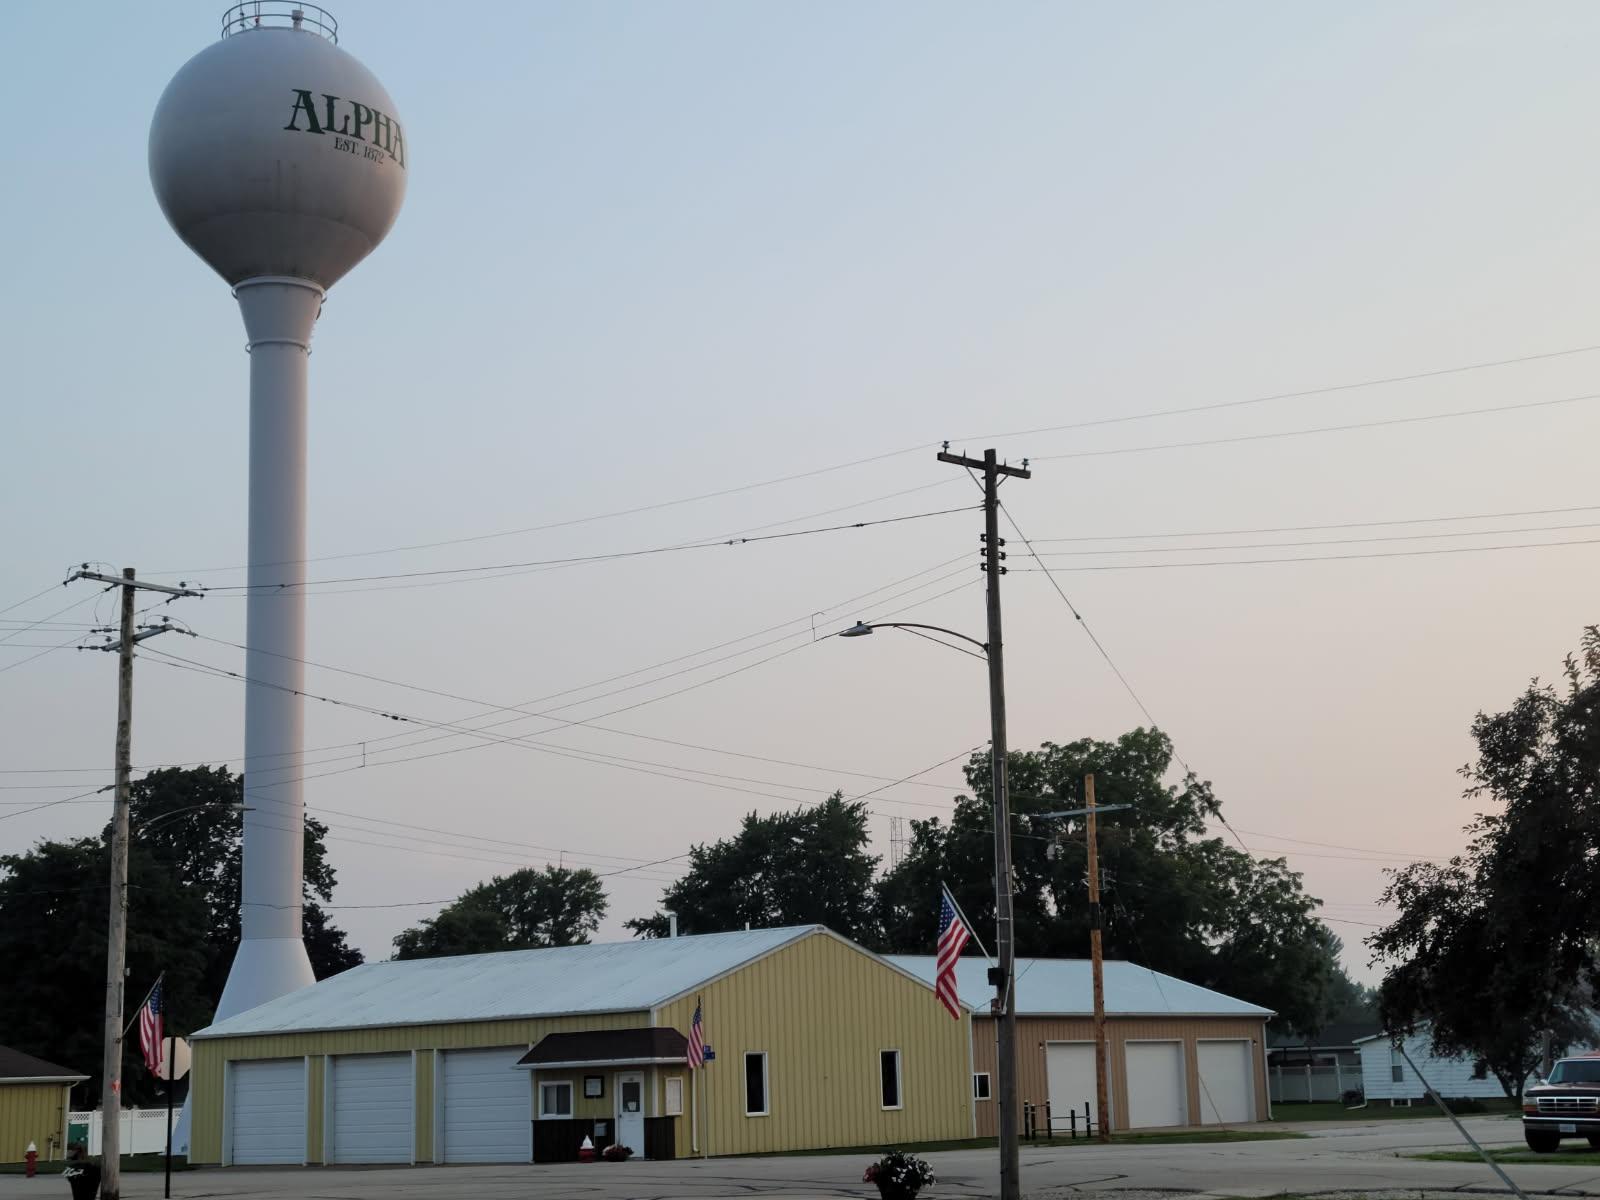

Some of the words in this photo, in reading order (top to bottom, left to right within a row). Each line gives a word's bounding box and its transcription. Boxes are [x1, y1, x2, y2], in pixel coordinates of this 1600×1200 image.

[283, 88, 405, 169] ALPHA
[333, 137, 360, 155] EST.
[363, 146, 385, 165] 1872
